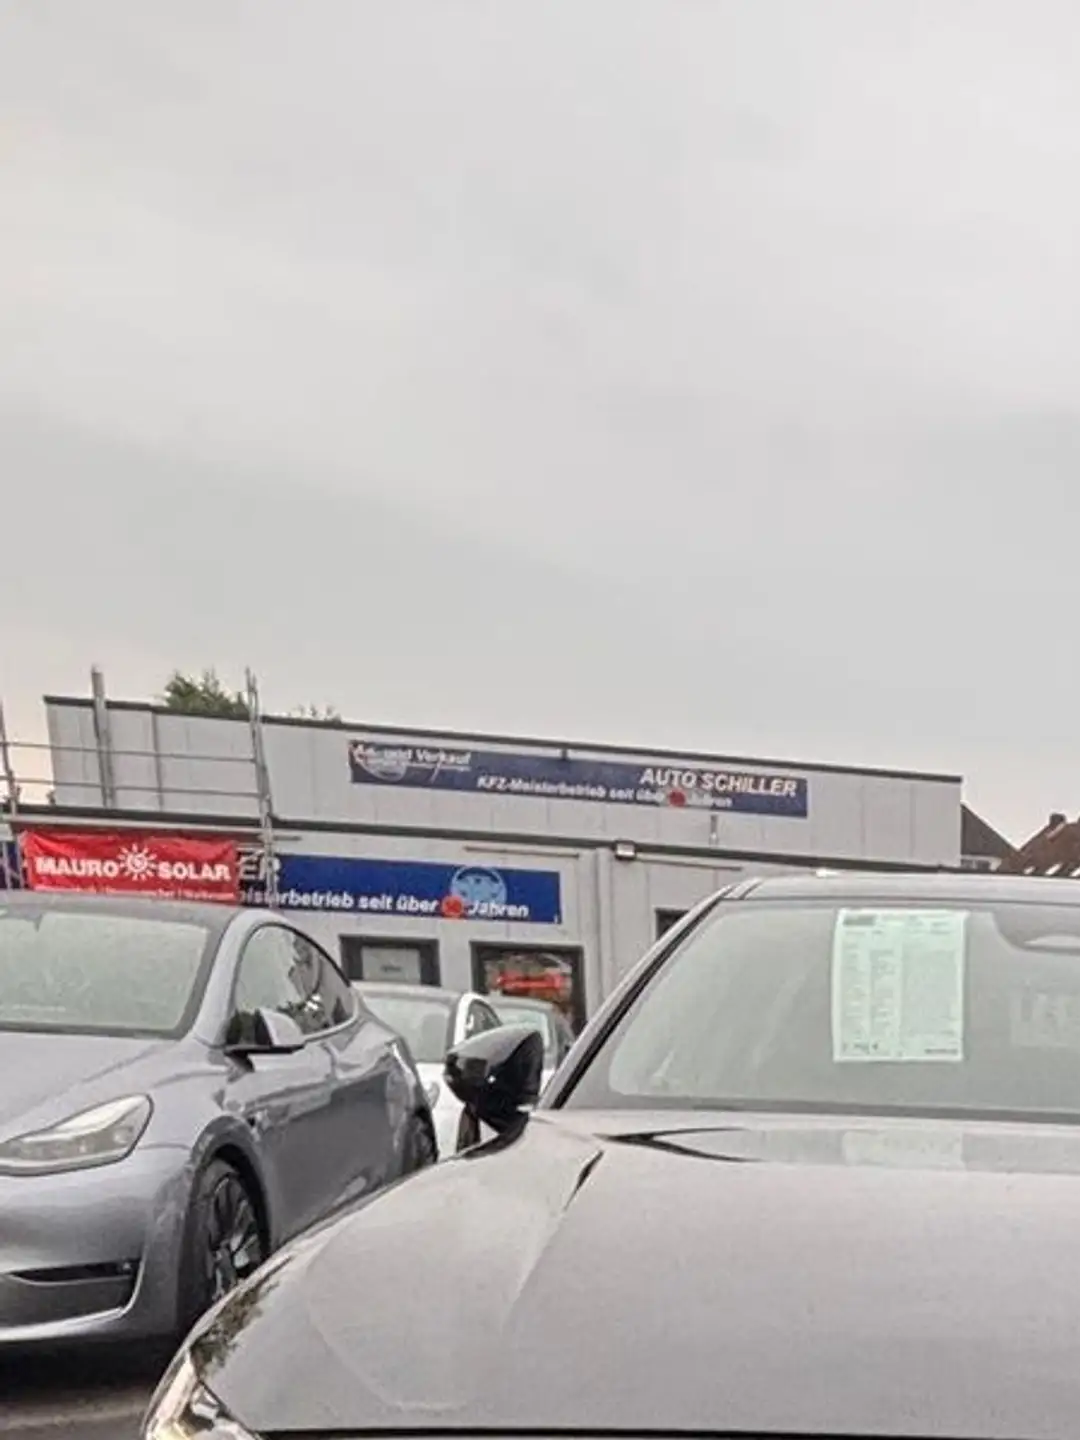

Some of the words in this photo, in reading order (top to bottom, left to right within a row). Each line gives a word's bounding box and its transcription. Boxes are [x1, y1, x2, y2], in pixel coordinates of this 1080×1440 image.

[639, 767, 697, 789] AUTO
[701, 772, 798, 798] SCHILLER
[35, 856, 119, 878] MAURO
[157, 863, 232, 881] SOLAR
[358, 893, 393, 910] seit
[395, 895, 439, 913] über
[466, 901, 529, 918] Jahren
